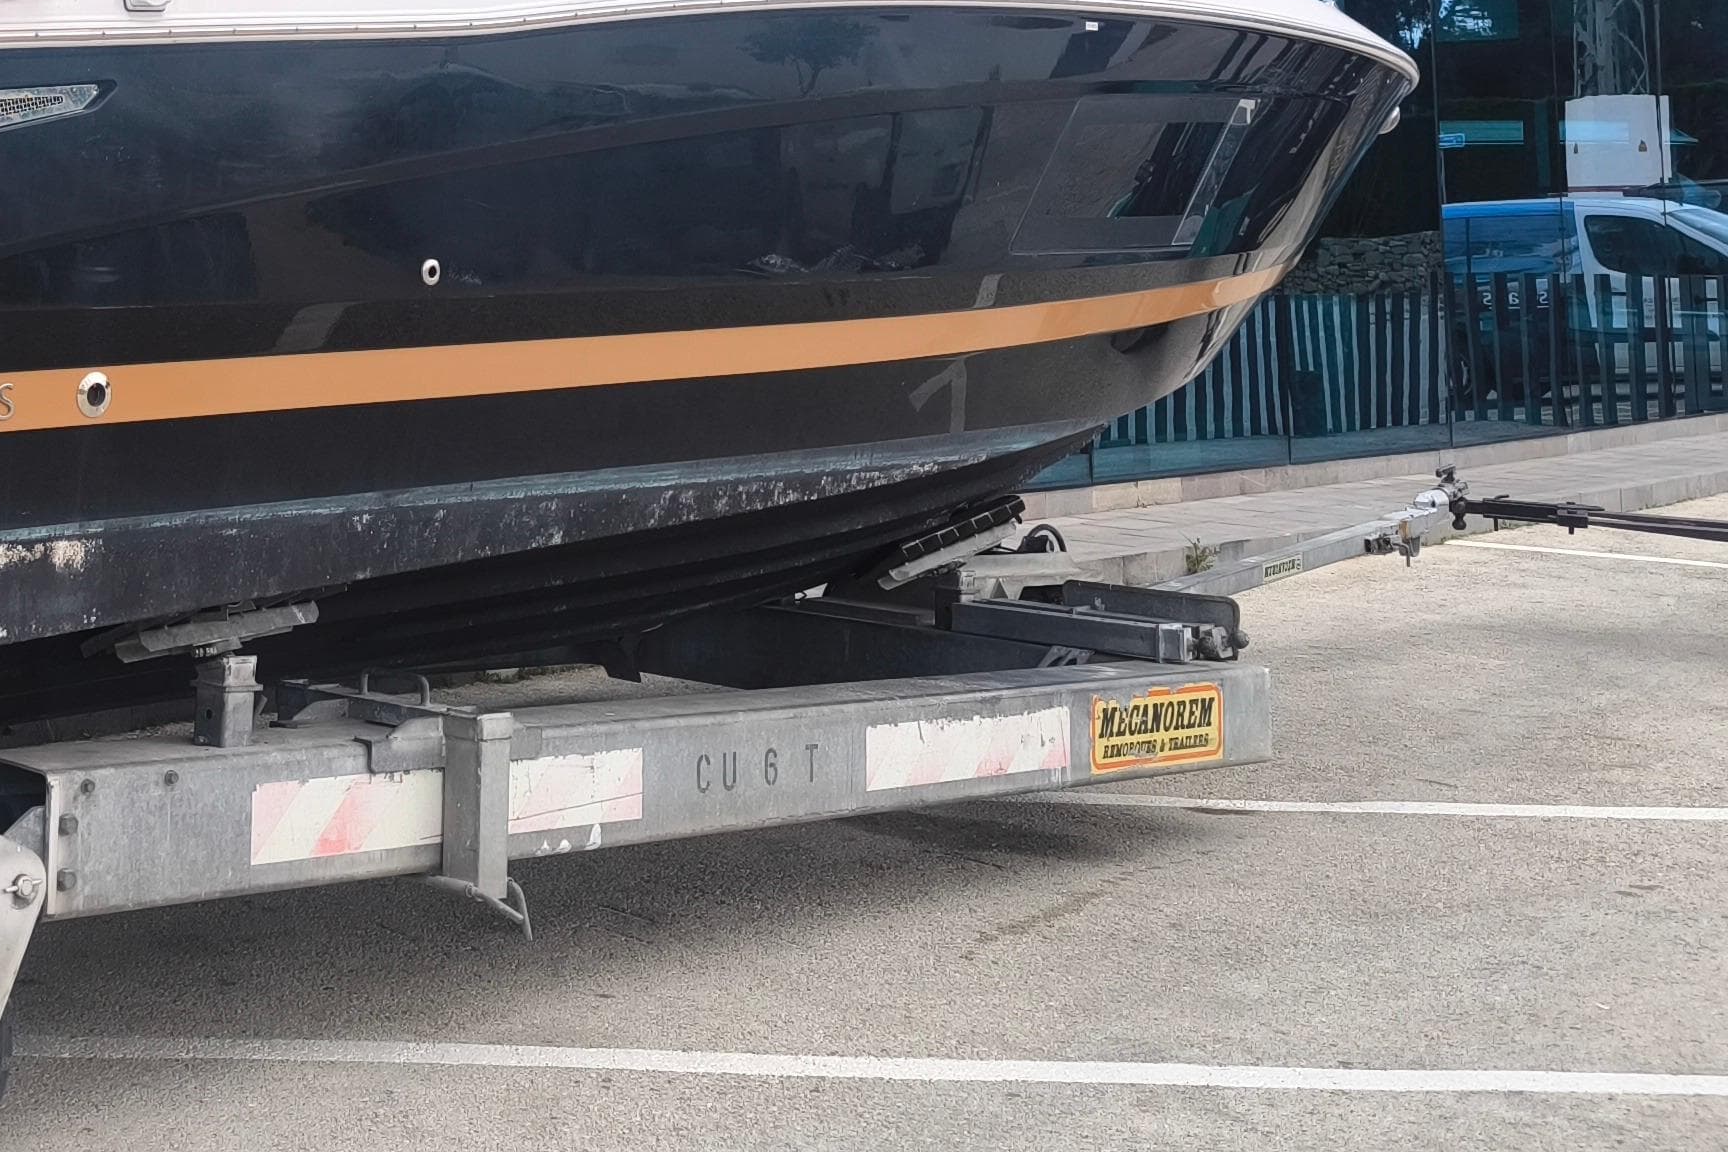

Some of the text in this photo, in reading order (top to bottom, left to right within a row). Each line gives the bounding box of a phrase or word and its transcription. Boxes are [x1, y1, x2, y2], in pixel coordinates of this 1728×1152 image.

[1098, 697, 1216, 739] MECANOREM
[1168, 733, 1210, 752] TRAILERS
[696, 743, 819, 794] CU 6 T
